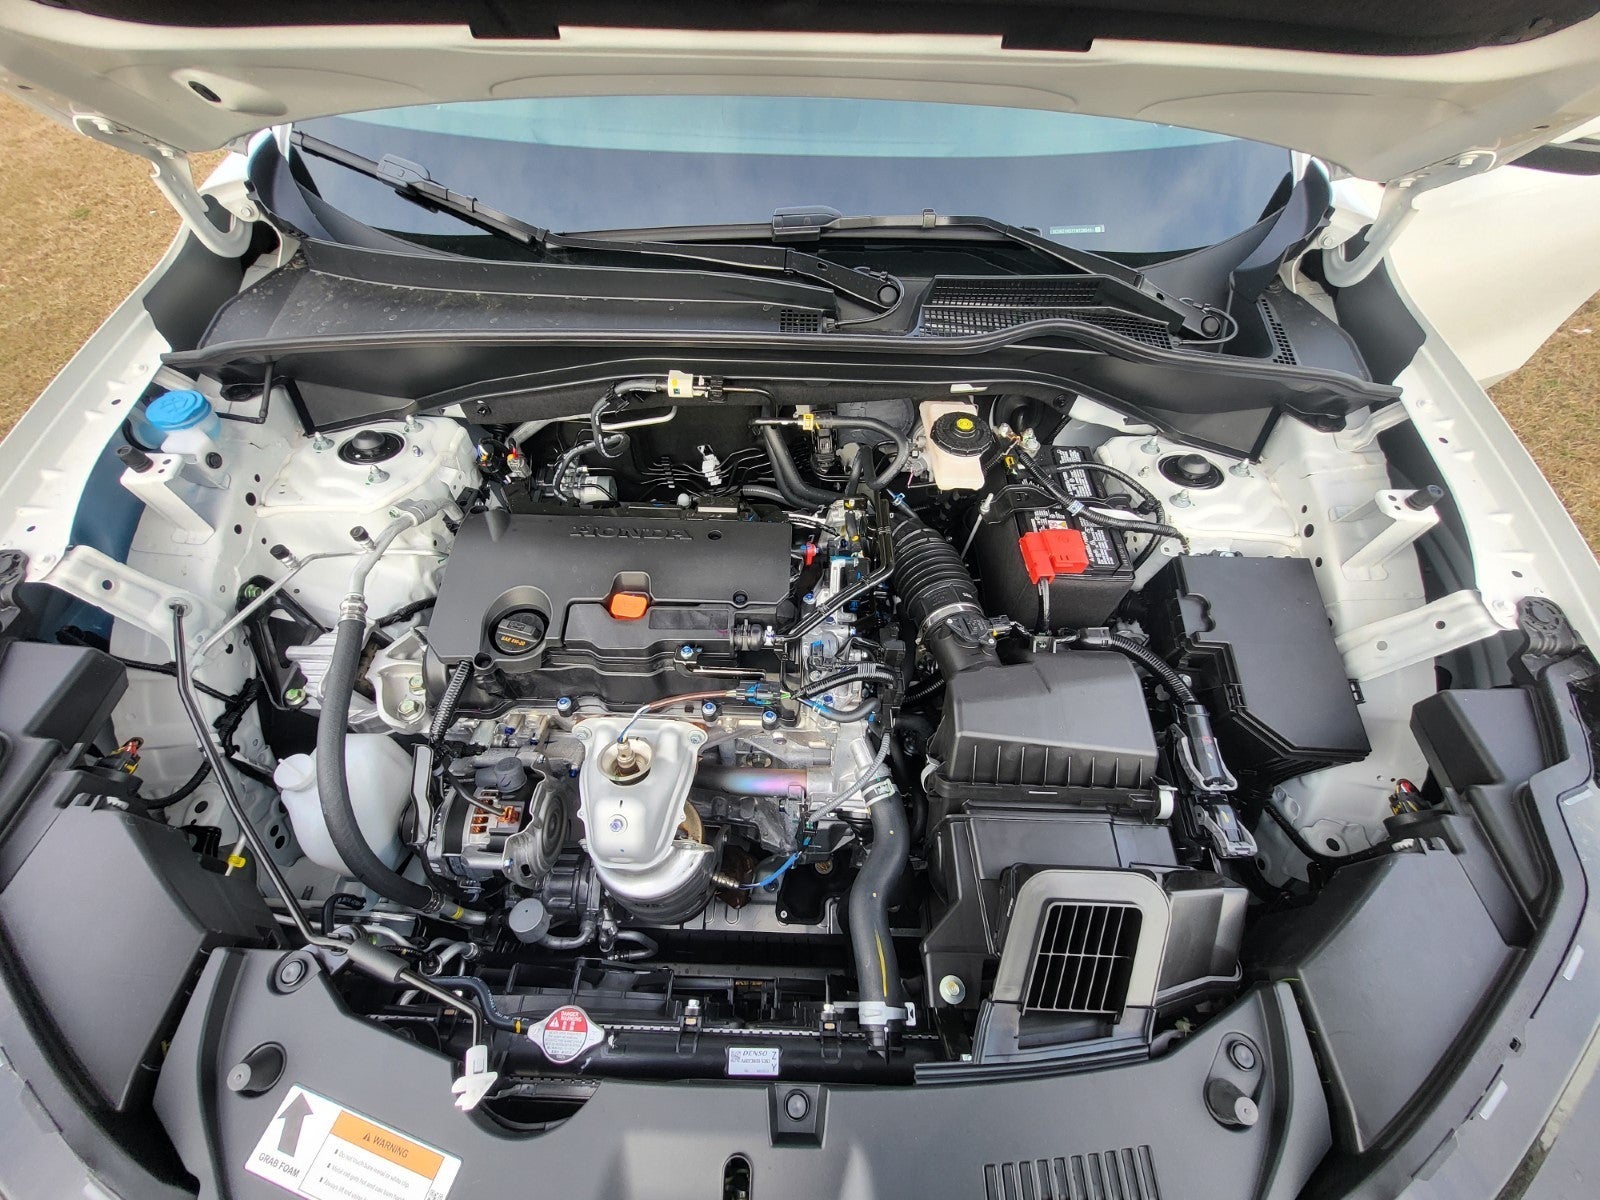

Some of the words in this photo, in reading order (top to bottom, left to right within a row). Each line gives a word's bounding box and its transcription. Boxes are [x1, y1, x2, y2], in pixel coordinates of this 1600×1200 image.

[569, 523, 694, 541] HONDA
[771, 1051, 777, 1060] Z
[771, 1063, 777, 1072] Y
[373, 1135, 410, 1158] WARNING
[258, 1152, 278, 1168] GRAB
[278, 1161, 300, 1178] FOAM
